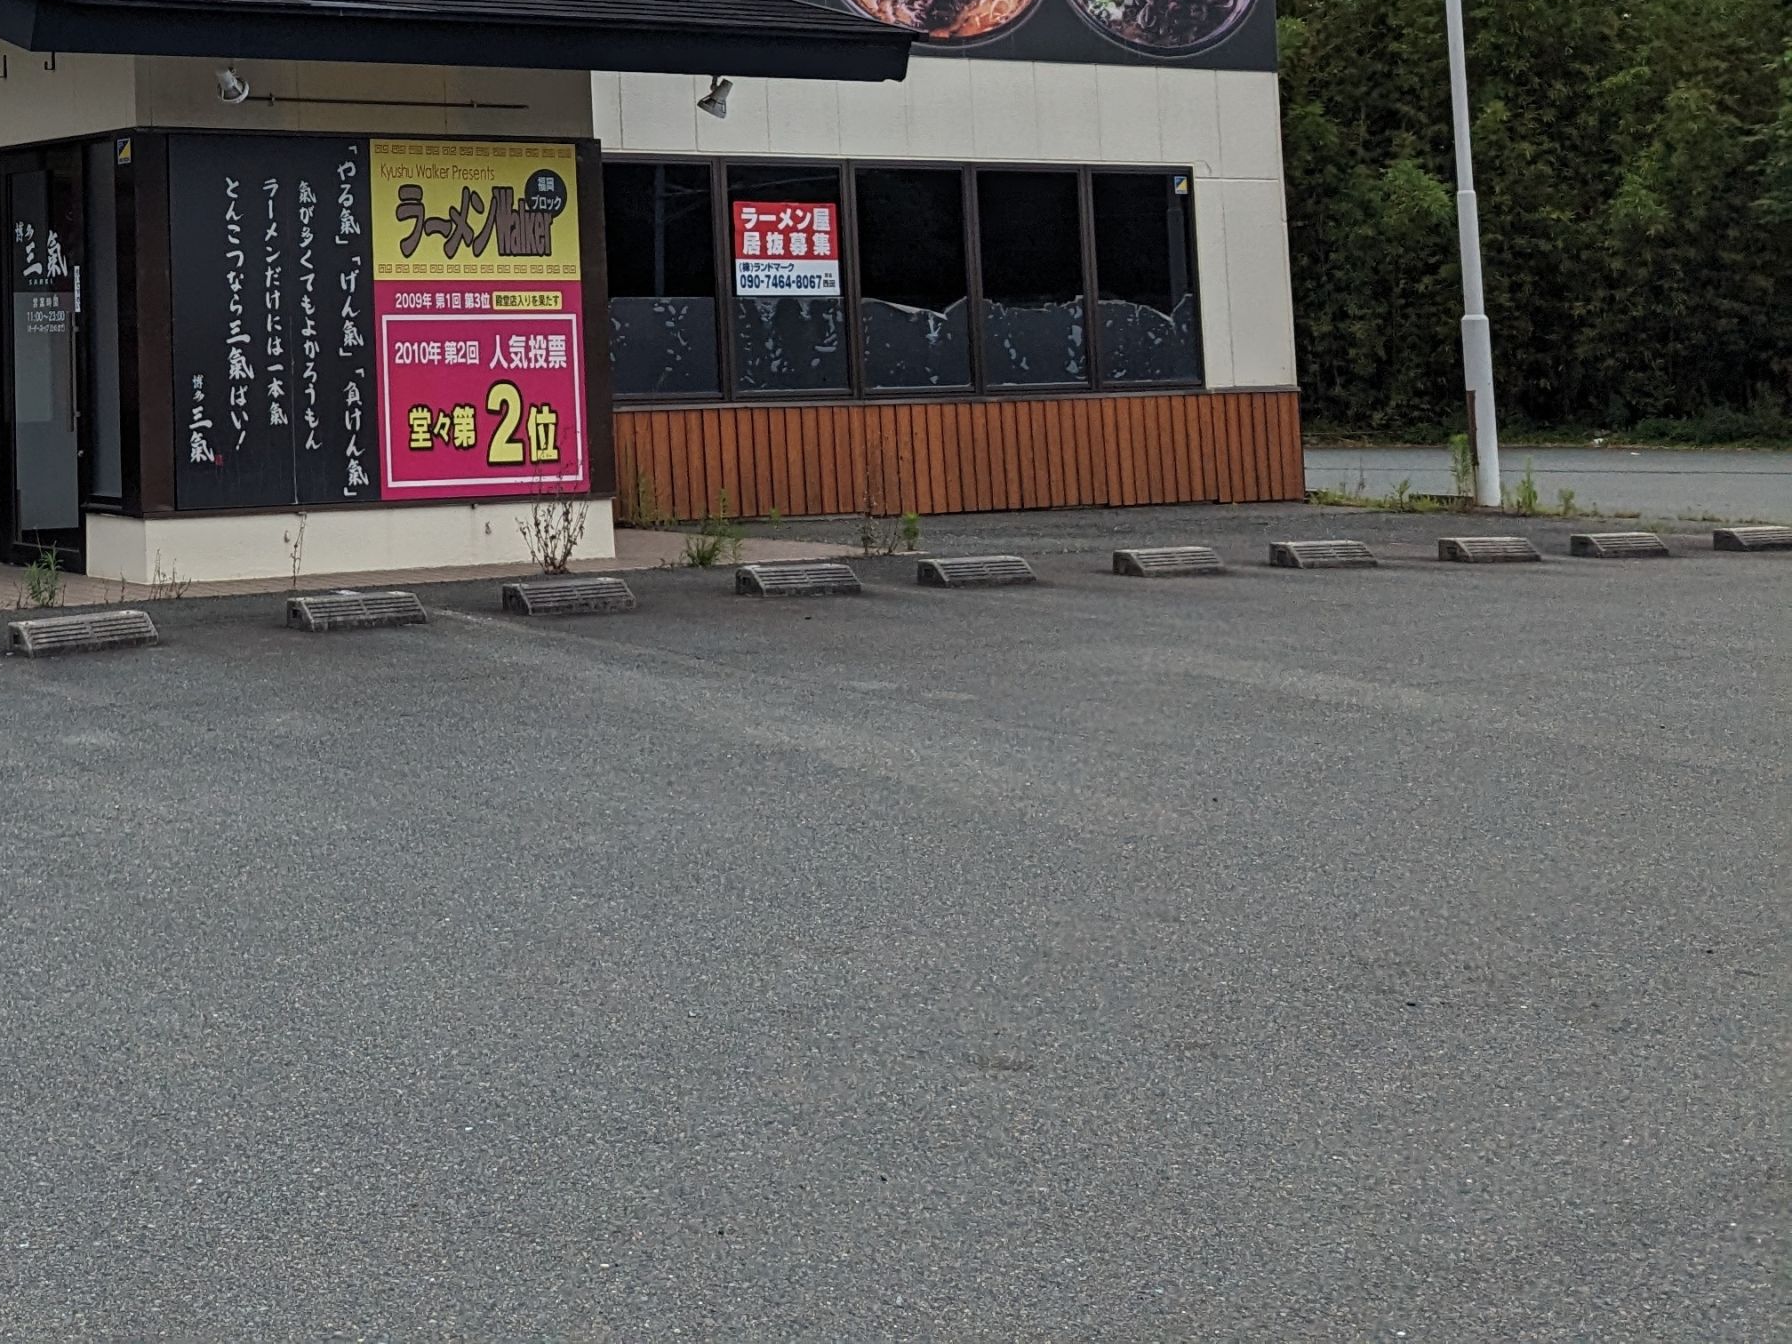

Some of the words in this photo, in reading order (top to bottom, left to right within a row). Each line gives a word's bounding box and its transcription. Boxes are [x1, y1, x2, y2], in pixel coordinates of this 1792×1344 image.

[380, 164, 414, 182] Kyushu
[415, 164, 450, 180] Walker
[452, 165, 495, 181] Presents
[536, 176, 555, 192] 福岡
[530, 195, 562, 211] ブロック
[740, 207, 831, 231] ラーメン屋
[742, 231, 831, 256] 居抜募集
[739, 274, 823, 289] 090-7464-8067
[395, 292, 433, 309] 2009年
[435, 292, 462, 309] 第1回
[464, 292, 491, 309] 第3位
[394, 341, 442, 365] 2010年
[444, 340, 480, 365] 第2回
[489, 334, 567, 370] 人気投票
